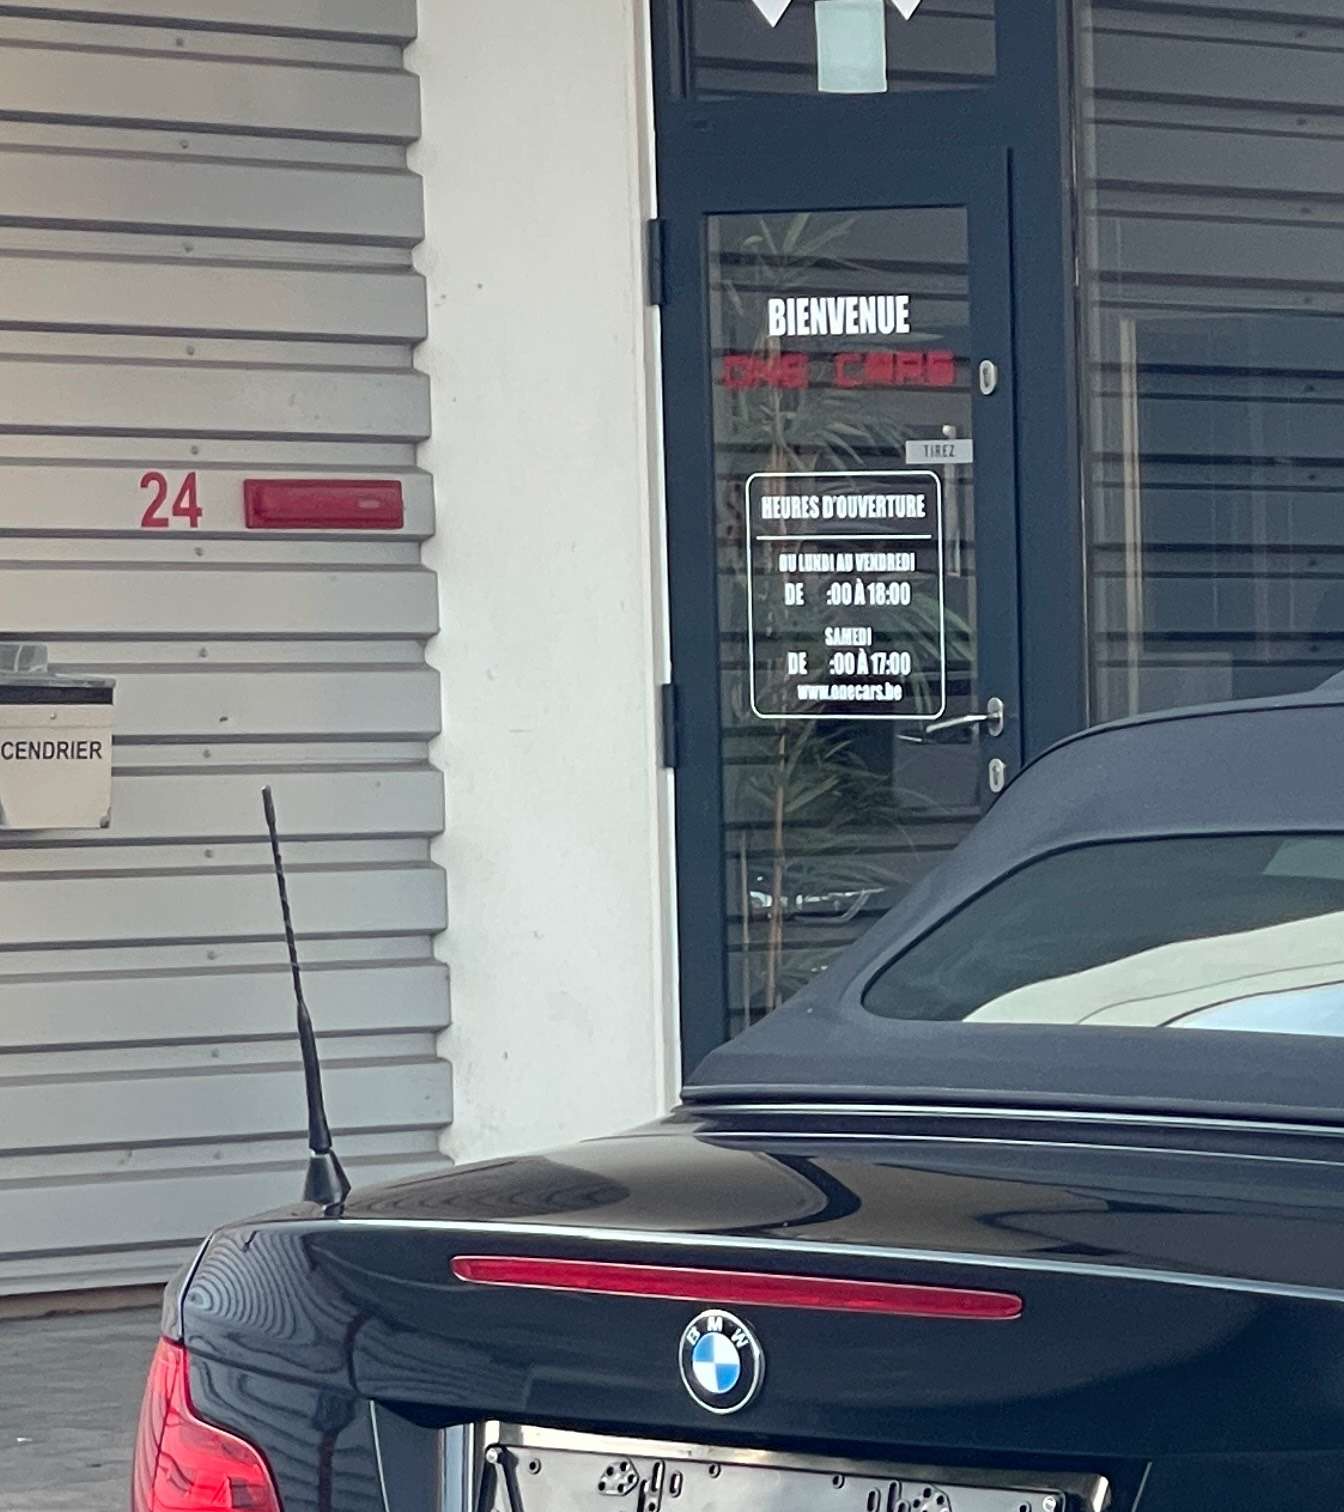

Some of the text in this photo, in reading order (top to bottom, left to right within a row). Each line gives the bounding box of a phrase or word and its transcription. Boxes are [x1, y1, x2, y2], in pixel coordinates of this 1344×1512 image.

[767, 295, 910, 335] BIENVENUE
[923, 443, 955, 458] TIREZ
[140, 471, 203, 529] 24
[761, 494, 926, 519] HEURES D'OUVERTURE
[779, 552, 915, 572] DU LUNDI AU VENDREDI
[784, 582, 804, 606] DE
[854, 577, 866, 606] À
[867, 582, 911, 606] 18:00
[825, 626, 872, 646] SAMEDI
[787, 651, 807, 675] DE
[857, 647, 869, 675] À
[870, 651, 911, 675] 17:00
[797, 681, 903, 701] www.onecars.be
[0, 740, 103, 760] CENDRIER
[686, 1315, 750, 1348] BMW
